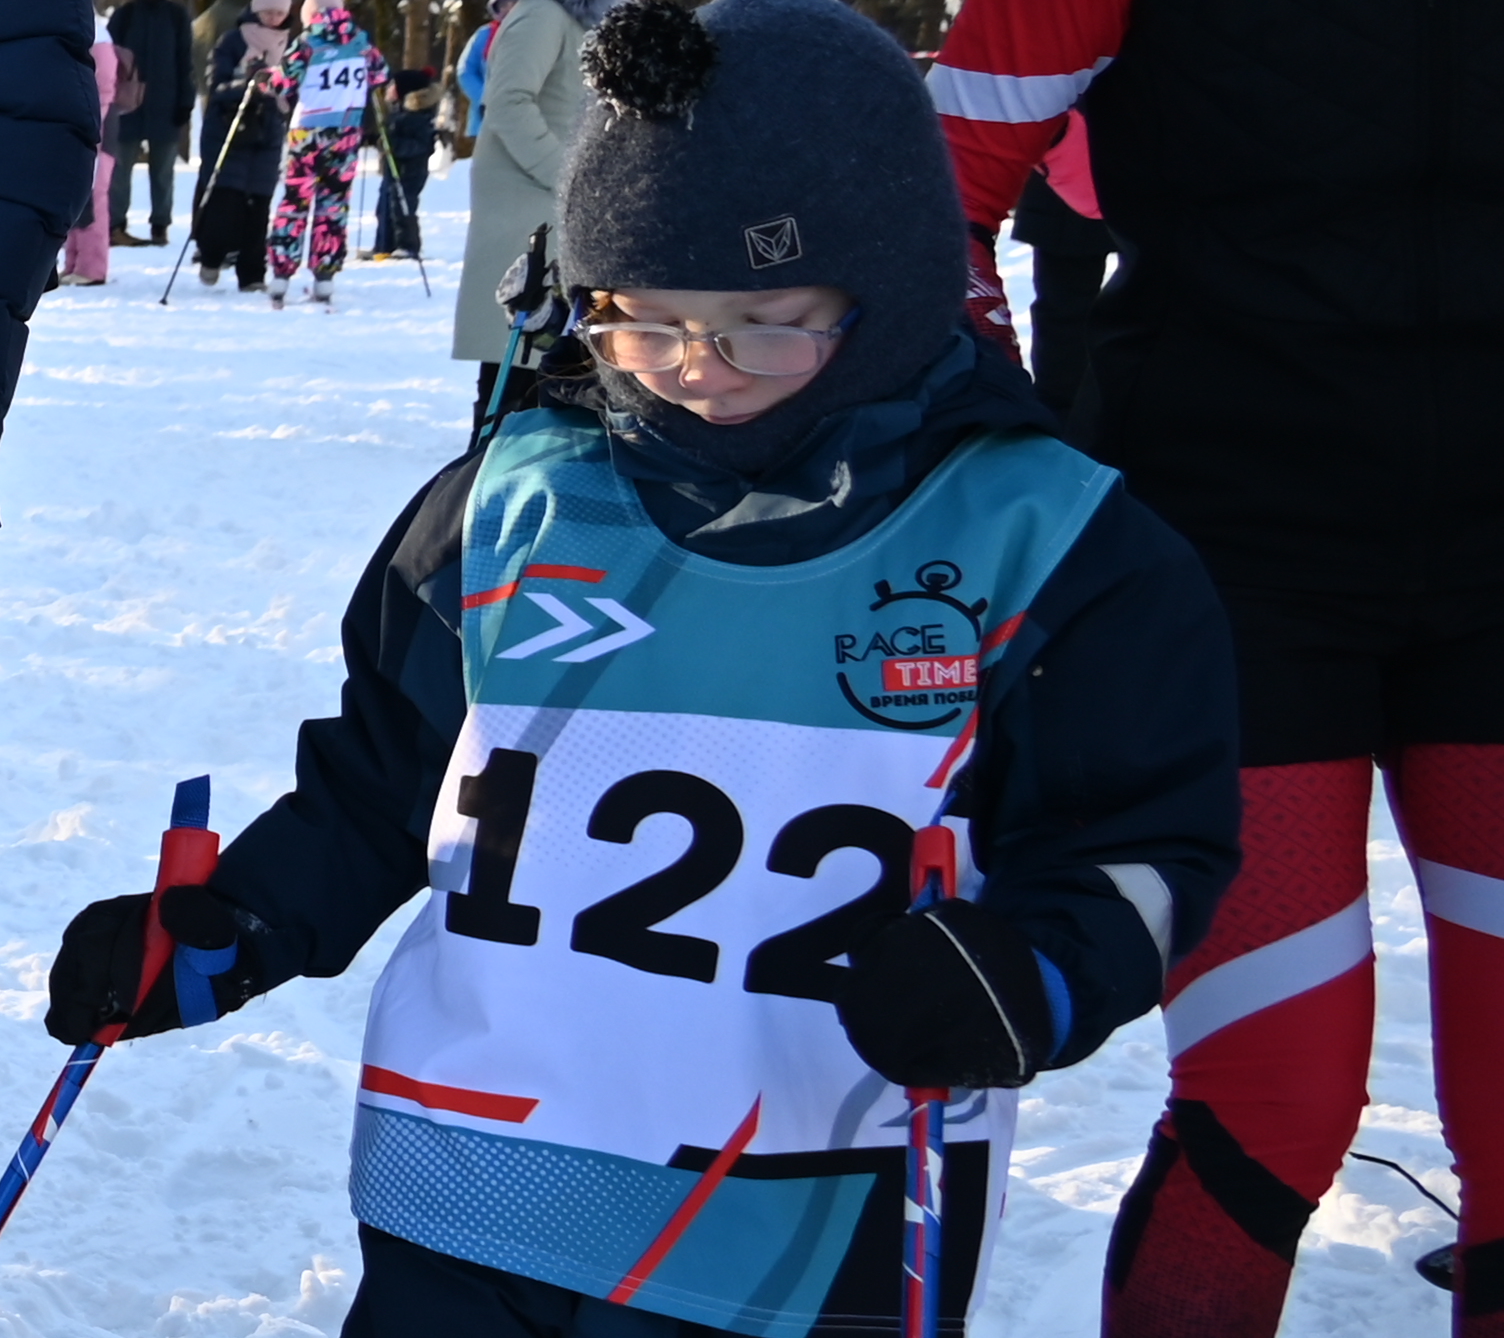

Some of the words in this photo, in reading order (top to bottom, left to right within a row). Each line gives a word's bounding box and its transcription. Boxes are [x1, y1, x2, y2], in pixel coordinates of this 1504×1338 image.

[319, 66, 366, 91] 149
[834, 624, 946, 665] RACE
[895, 658, 978, 687] TIME
[869, 692, 929, 709] ВРЕМЯ
[933, 689, 980, 706] ПОБЕ
[444, 747, 920, 1003] 122
